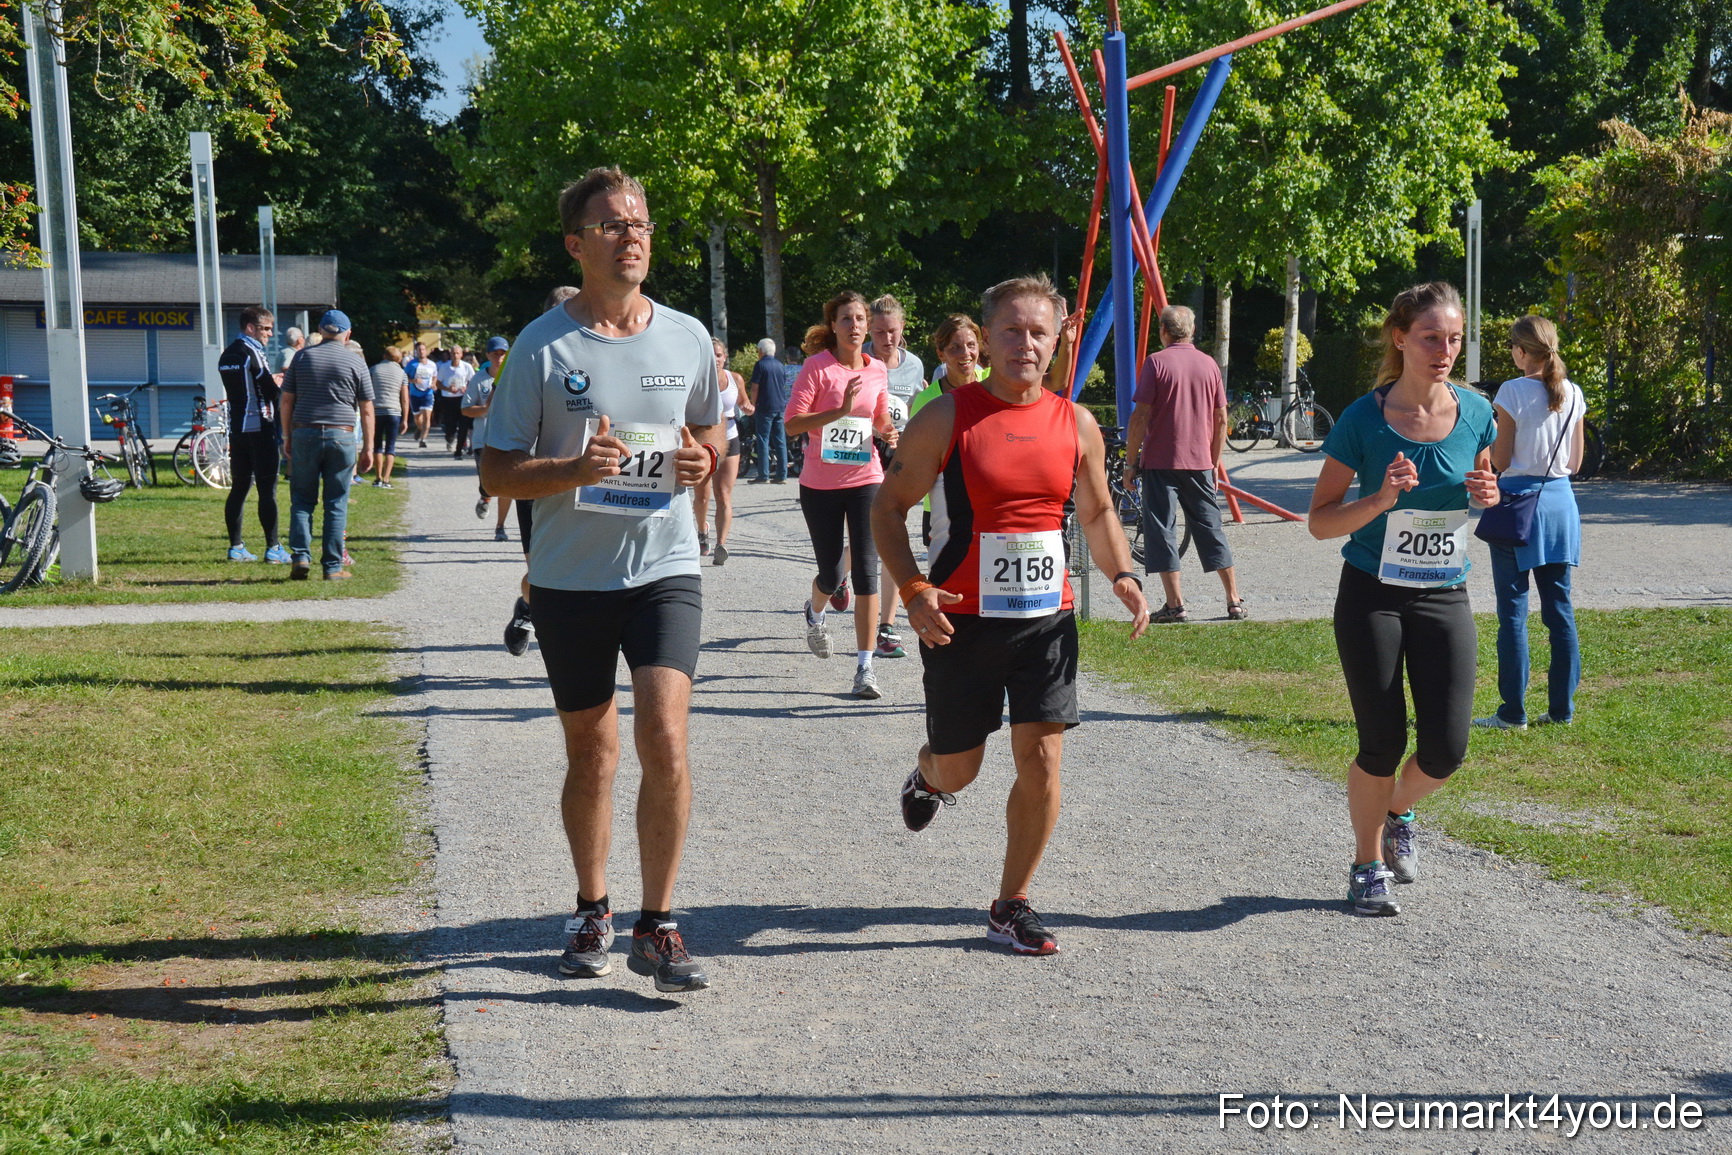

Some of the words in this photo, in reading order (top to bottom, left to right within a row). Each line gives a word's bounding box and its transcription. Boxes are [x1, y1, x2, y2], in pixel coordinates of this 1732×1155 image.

[84, 310, 128, 325] CAFE
[640, 375, 686, 387] BOCK
[566, 398, 593, 407] PARTL
[614, 430, 655, 442] BOCK
[830, 428, 863, 445] 2471
[600, 479, 621, 487] PARTL
[603, 491, 650, 507] Andreas
[1412, 517, 1446, 527] BOCK
[1007, 540, 1044, 550] BOCK
[1396, 530, 1455, 556] 2035
[1400, 557, 1418, 565] PARTL
[993, 556, 1054, 582] 2158
[1398, 567, 1446, 580] Franziska
[1007, 597, 1043, 609] Werner
